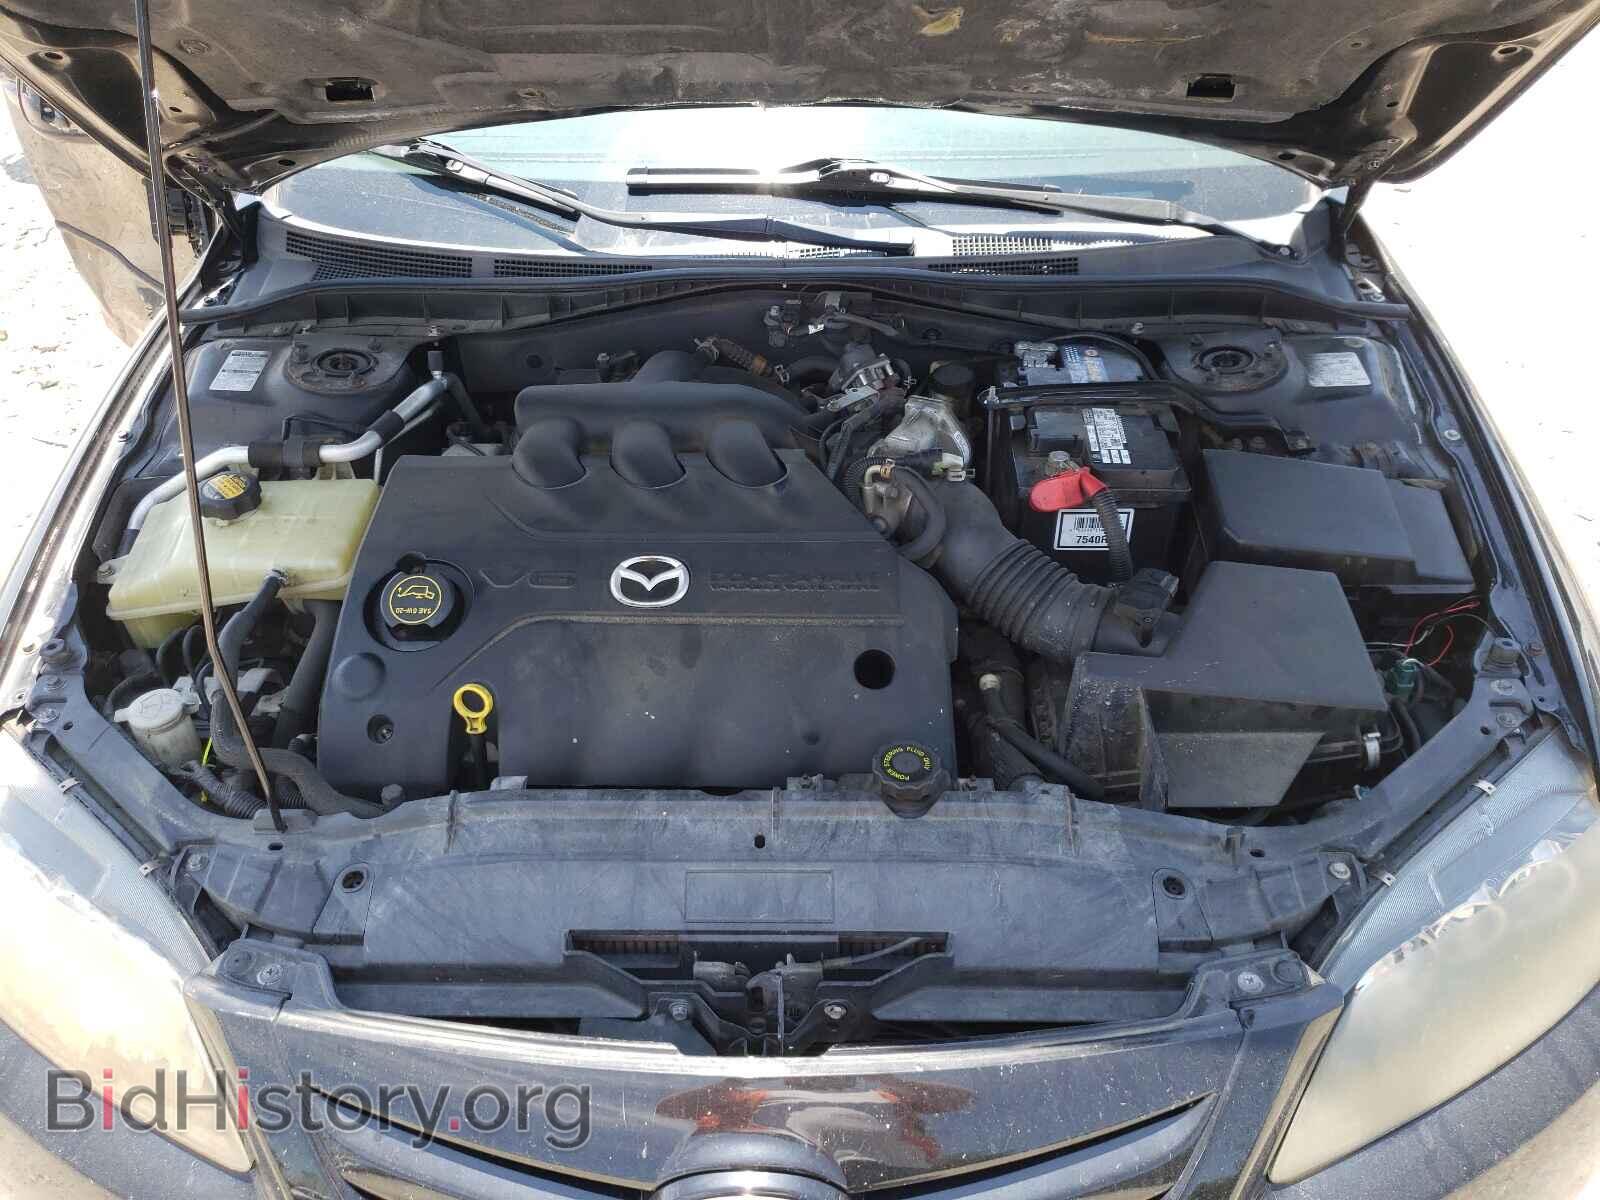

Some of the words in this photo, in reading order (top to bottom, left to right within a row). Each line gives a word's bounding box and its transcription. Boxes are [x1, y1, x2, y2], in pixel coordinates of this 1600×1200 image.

[883, 747, 904, 767] STEERING
[906, 746, 925, 757] FLUID
[923, 757, 931, 770] ONLY
[887, 768, 910, 781] POWER
